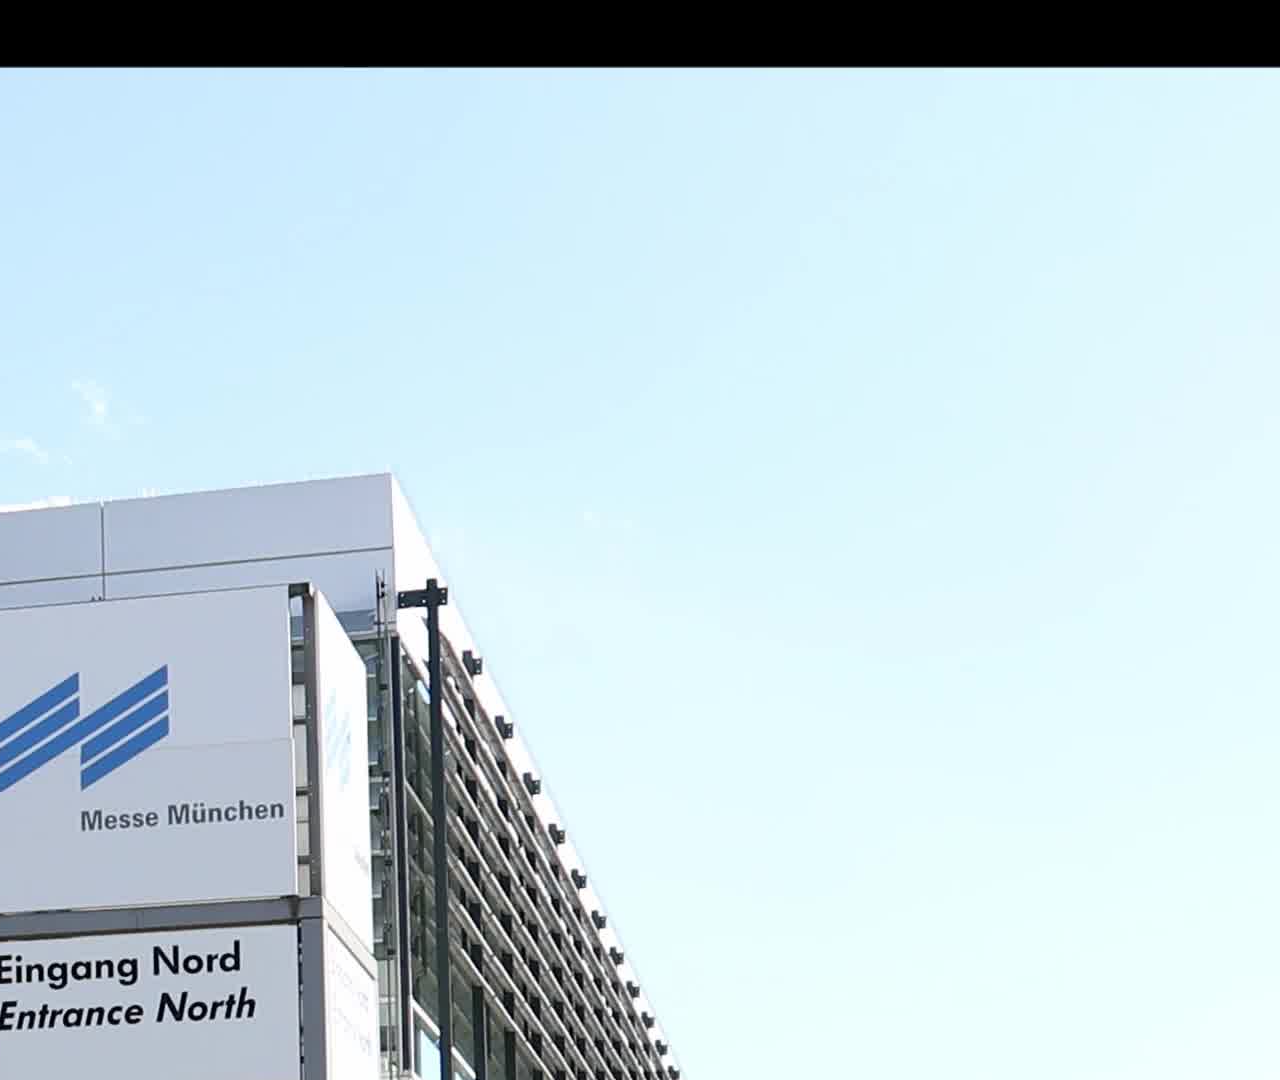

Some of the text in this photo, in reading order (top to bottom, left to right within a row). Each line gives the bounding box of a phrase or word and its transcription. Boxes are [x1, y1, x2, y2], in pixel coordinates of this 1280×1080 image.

[81, 800, 284, 832] Messe München
[152, 939, 241, 976] Nord
[156, 986, 257, 1022] North
